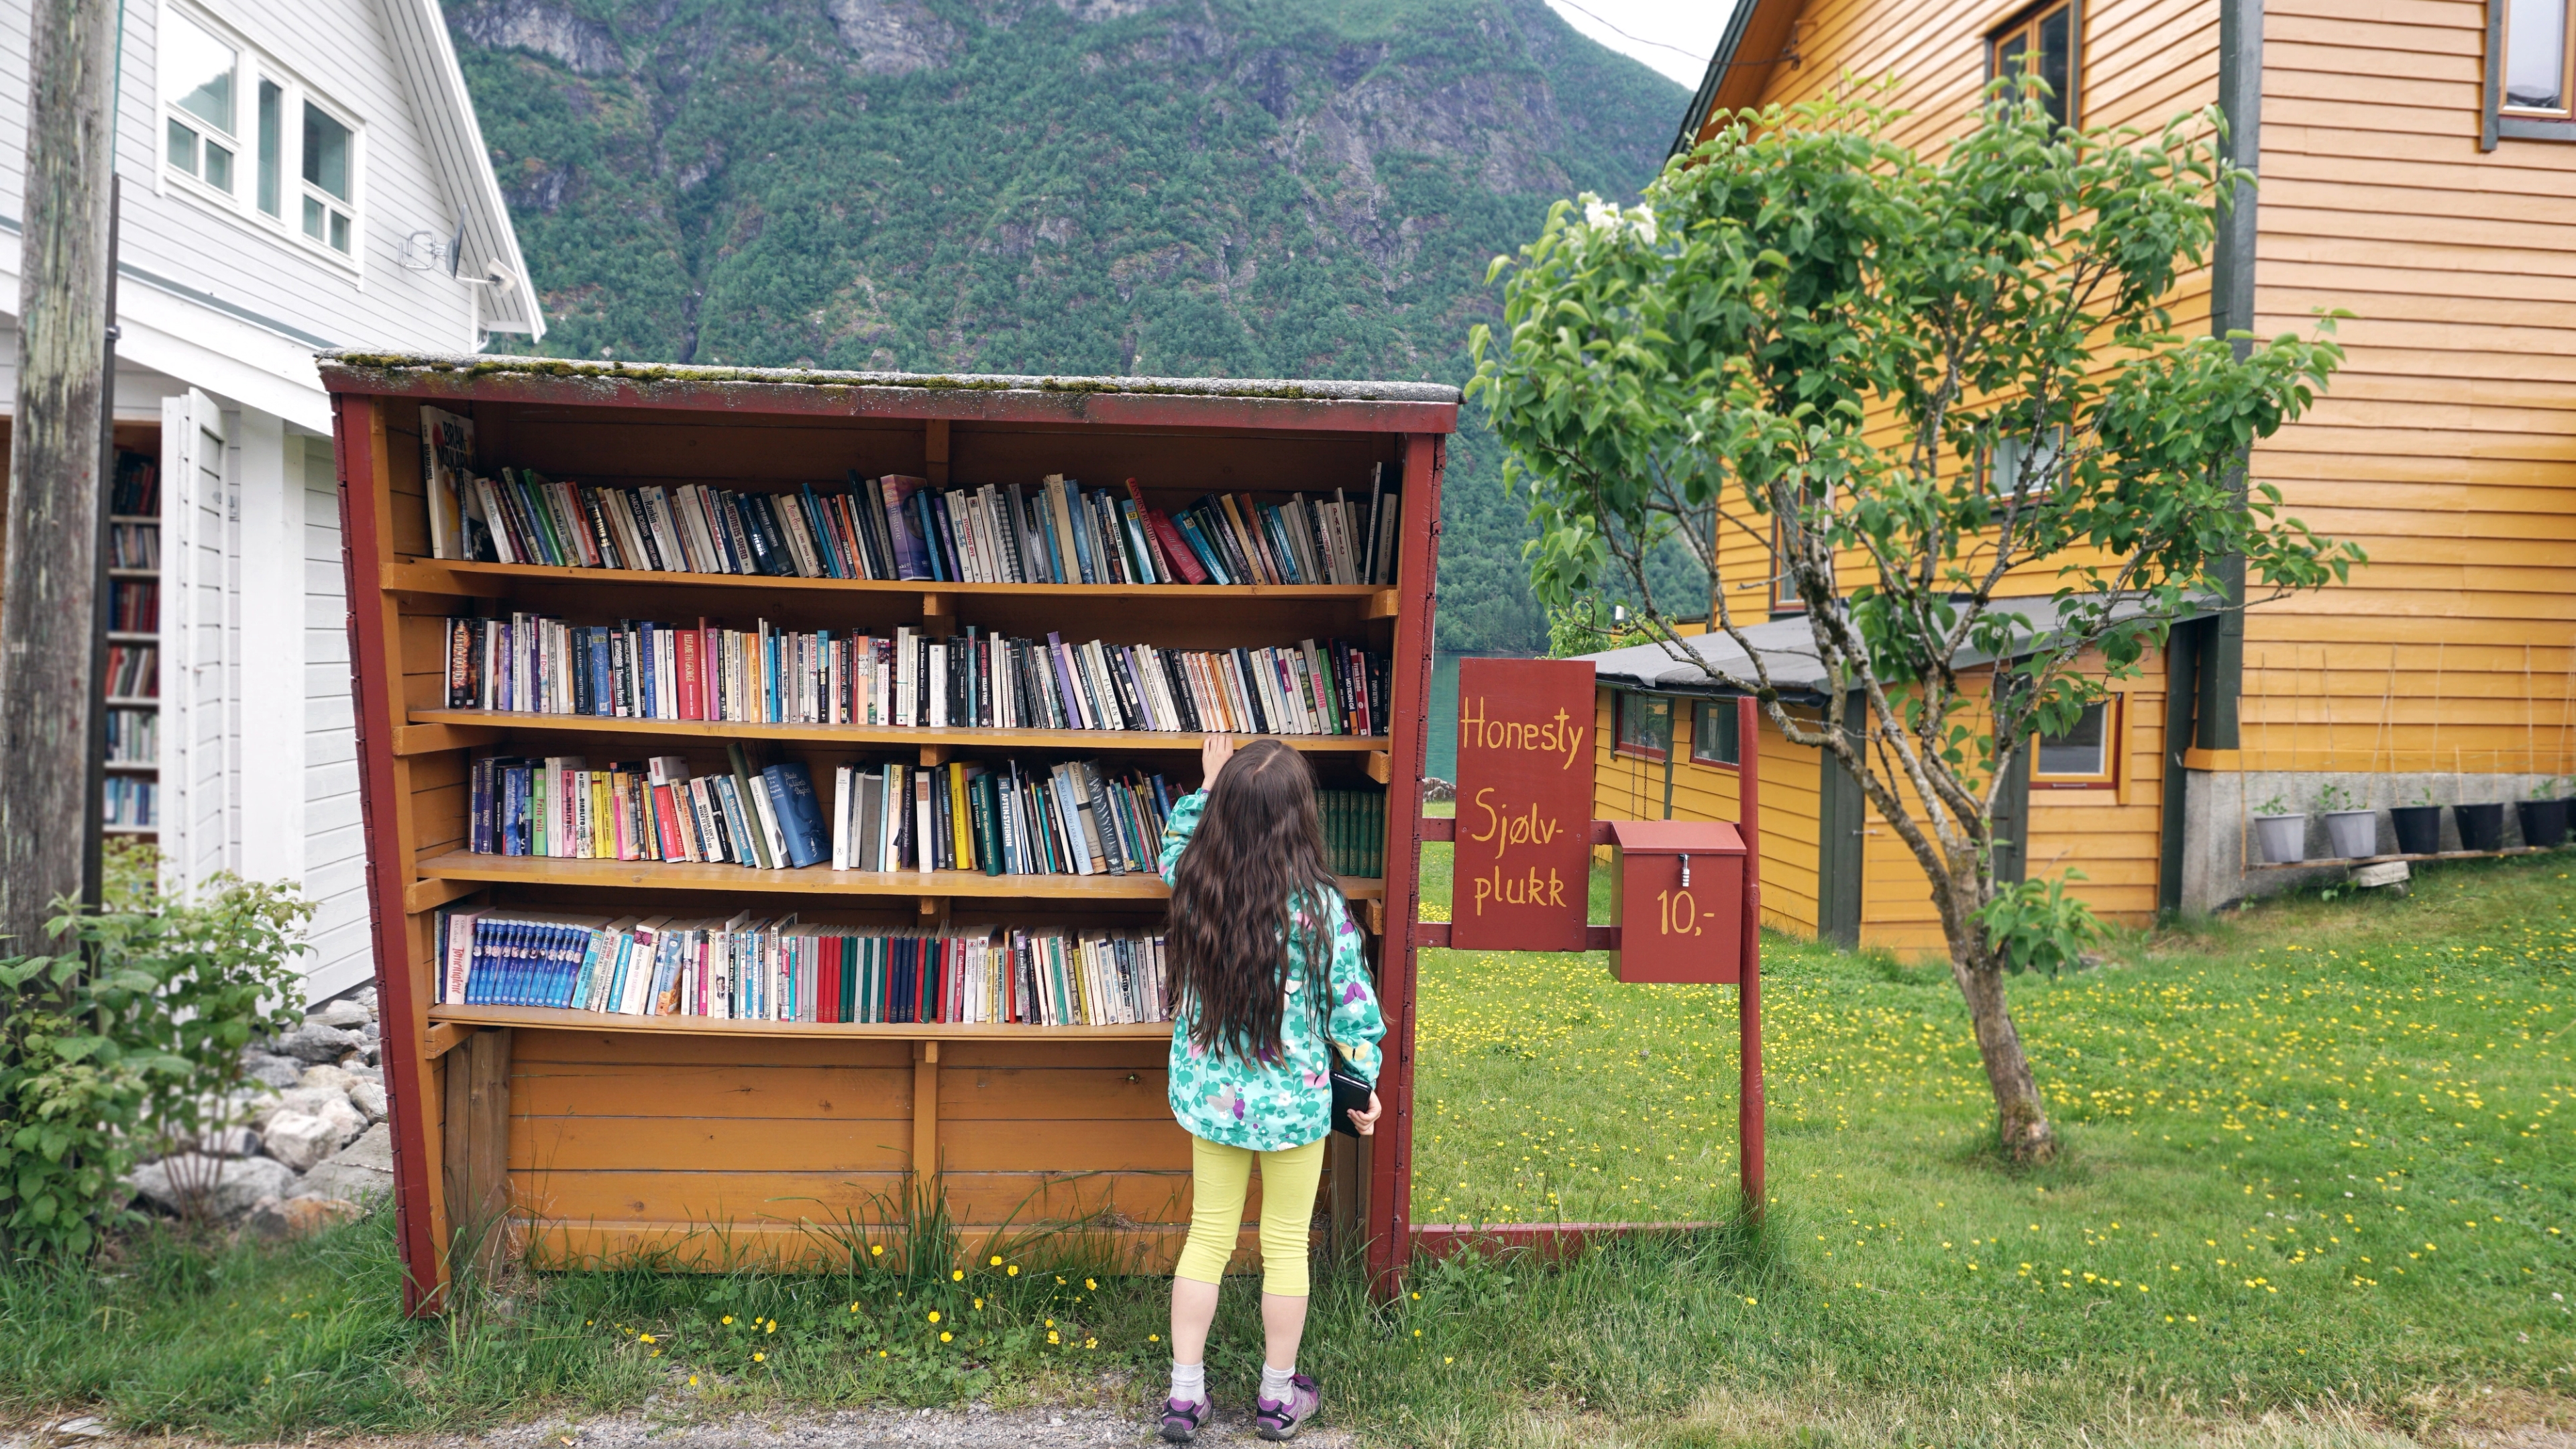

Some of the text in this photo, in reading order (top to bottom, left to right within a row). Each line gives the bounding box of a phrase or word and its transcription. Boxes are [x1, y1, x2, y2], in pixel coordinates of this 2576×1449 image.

[629, 494, 650, 536] HAROLD ROBBINS
[645, 501, 657, 523] Rankin
[887, 489, 902, 541] Kunsthistorie
[1130, 481, 1140, 496] FINN
[1135, 497, 1144, 509] DIN
[1141, 511, 1155, 541] FREMTID
[963, 518, 972, 546] STORMENS
[1326, 554, 1334, 568] pass
[684, 634, 695, 682] ELIZABETH GEORGE
[810, 637, 816, 645] ED
[645, 647, 653, 680] GUILLOU
[1090, 667, 1102, 692] OPERASJON
[616, 669, 625, 706] Thomas Harris
[1104, 678, 1118, 716] FLUKTEN
[1460, 696, 1583, 769] Honesty
[692, 782, 700, 803] SIGNORET
[702, 804, 711, 828] NOSTALGIA
[1471, 788, 1564, 859] Sjølv-
[1474, 866, 1566, 916] plukk
[1657, 890, 1715, 936] 10,-
